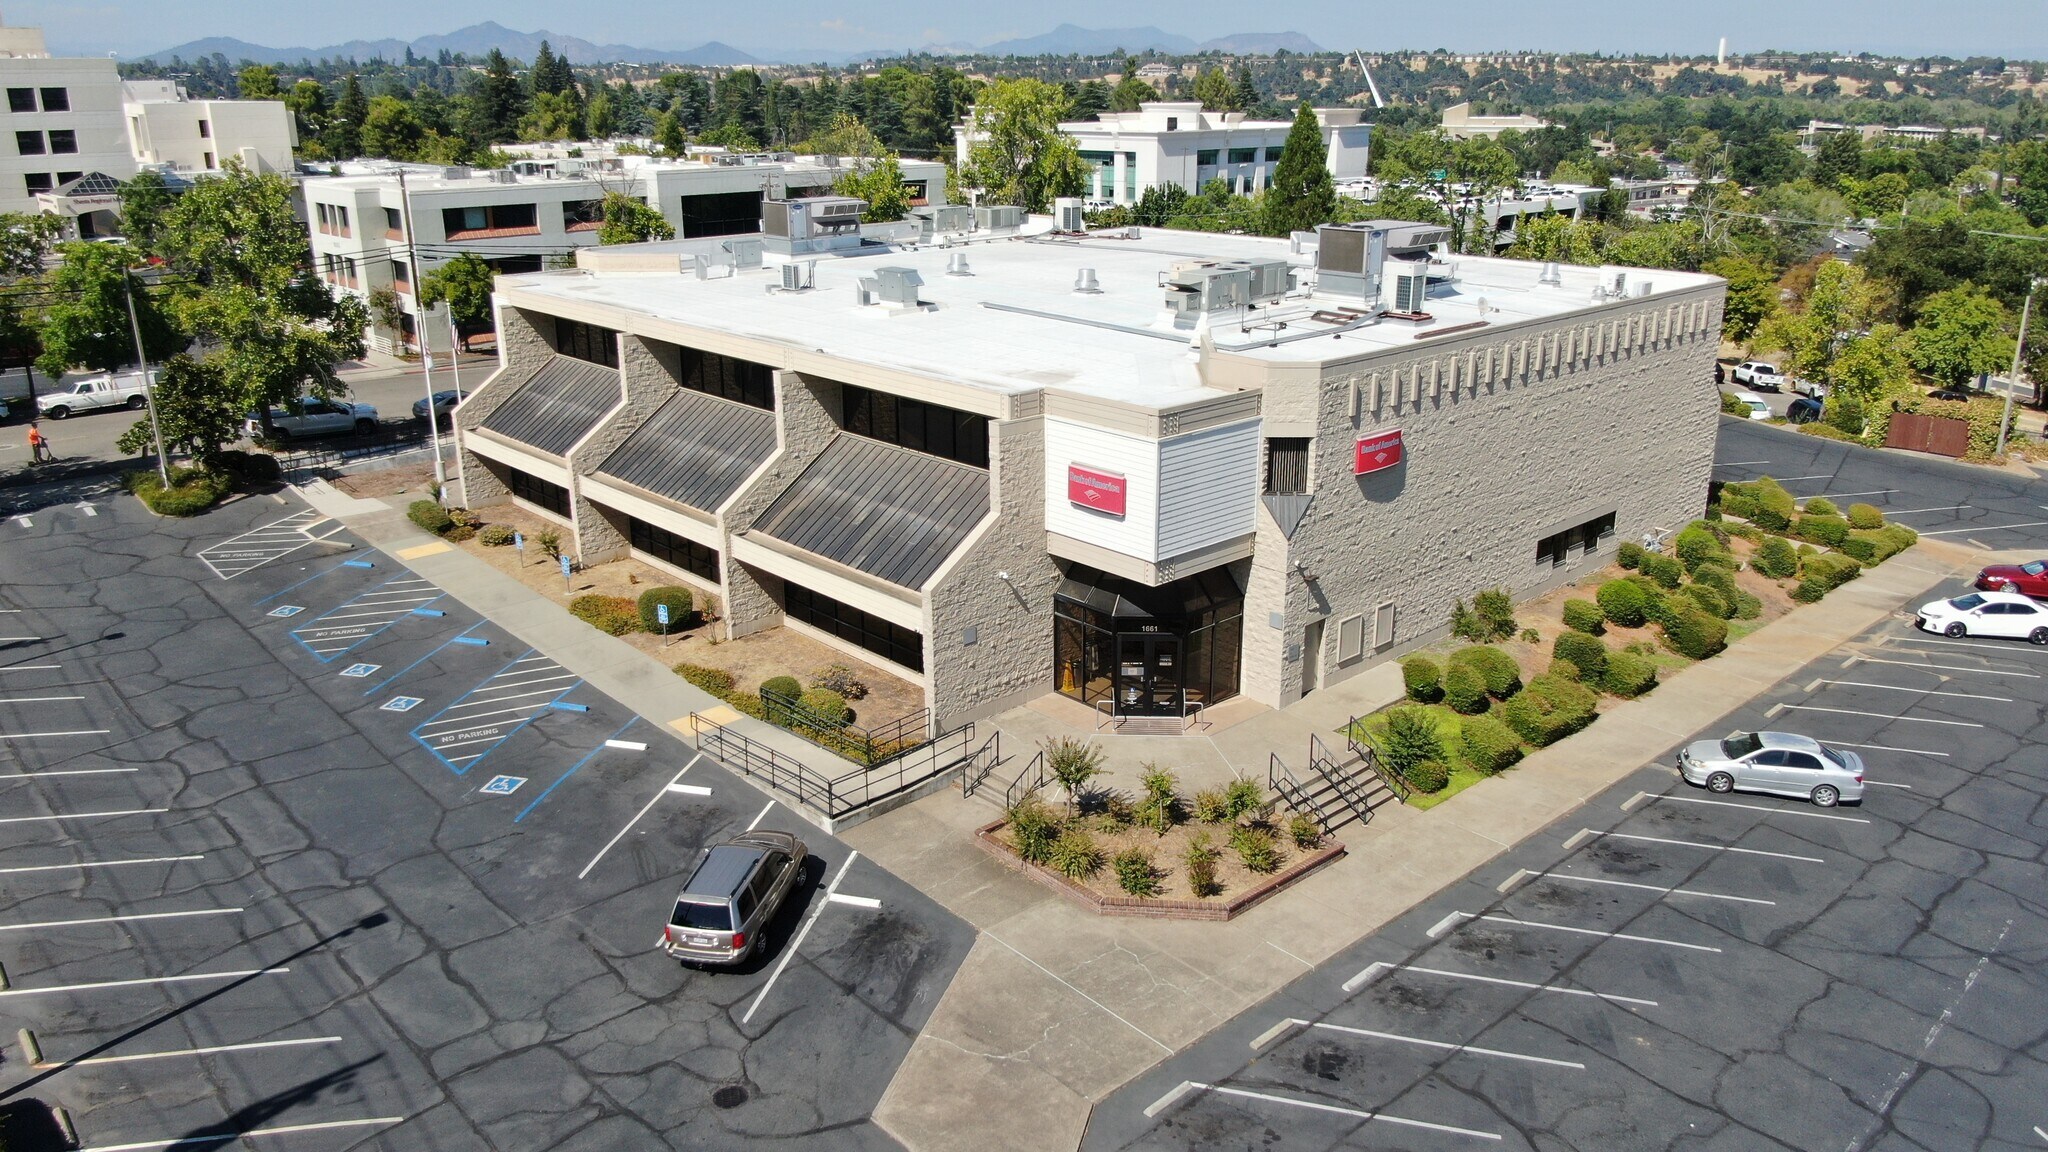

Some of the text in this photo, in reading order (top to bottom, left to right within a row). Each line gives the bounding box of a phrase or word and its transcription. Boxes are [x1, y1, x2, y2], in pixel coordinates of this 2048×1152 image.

[1361, 444, 1375, 454] Bank
[1382, 438, 1399, 449] America
[1070, 472, 1085, 485] Bank
[1092, 478, 1120, 493] America
[441, 728, 499, 743] NO PARKING
